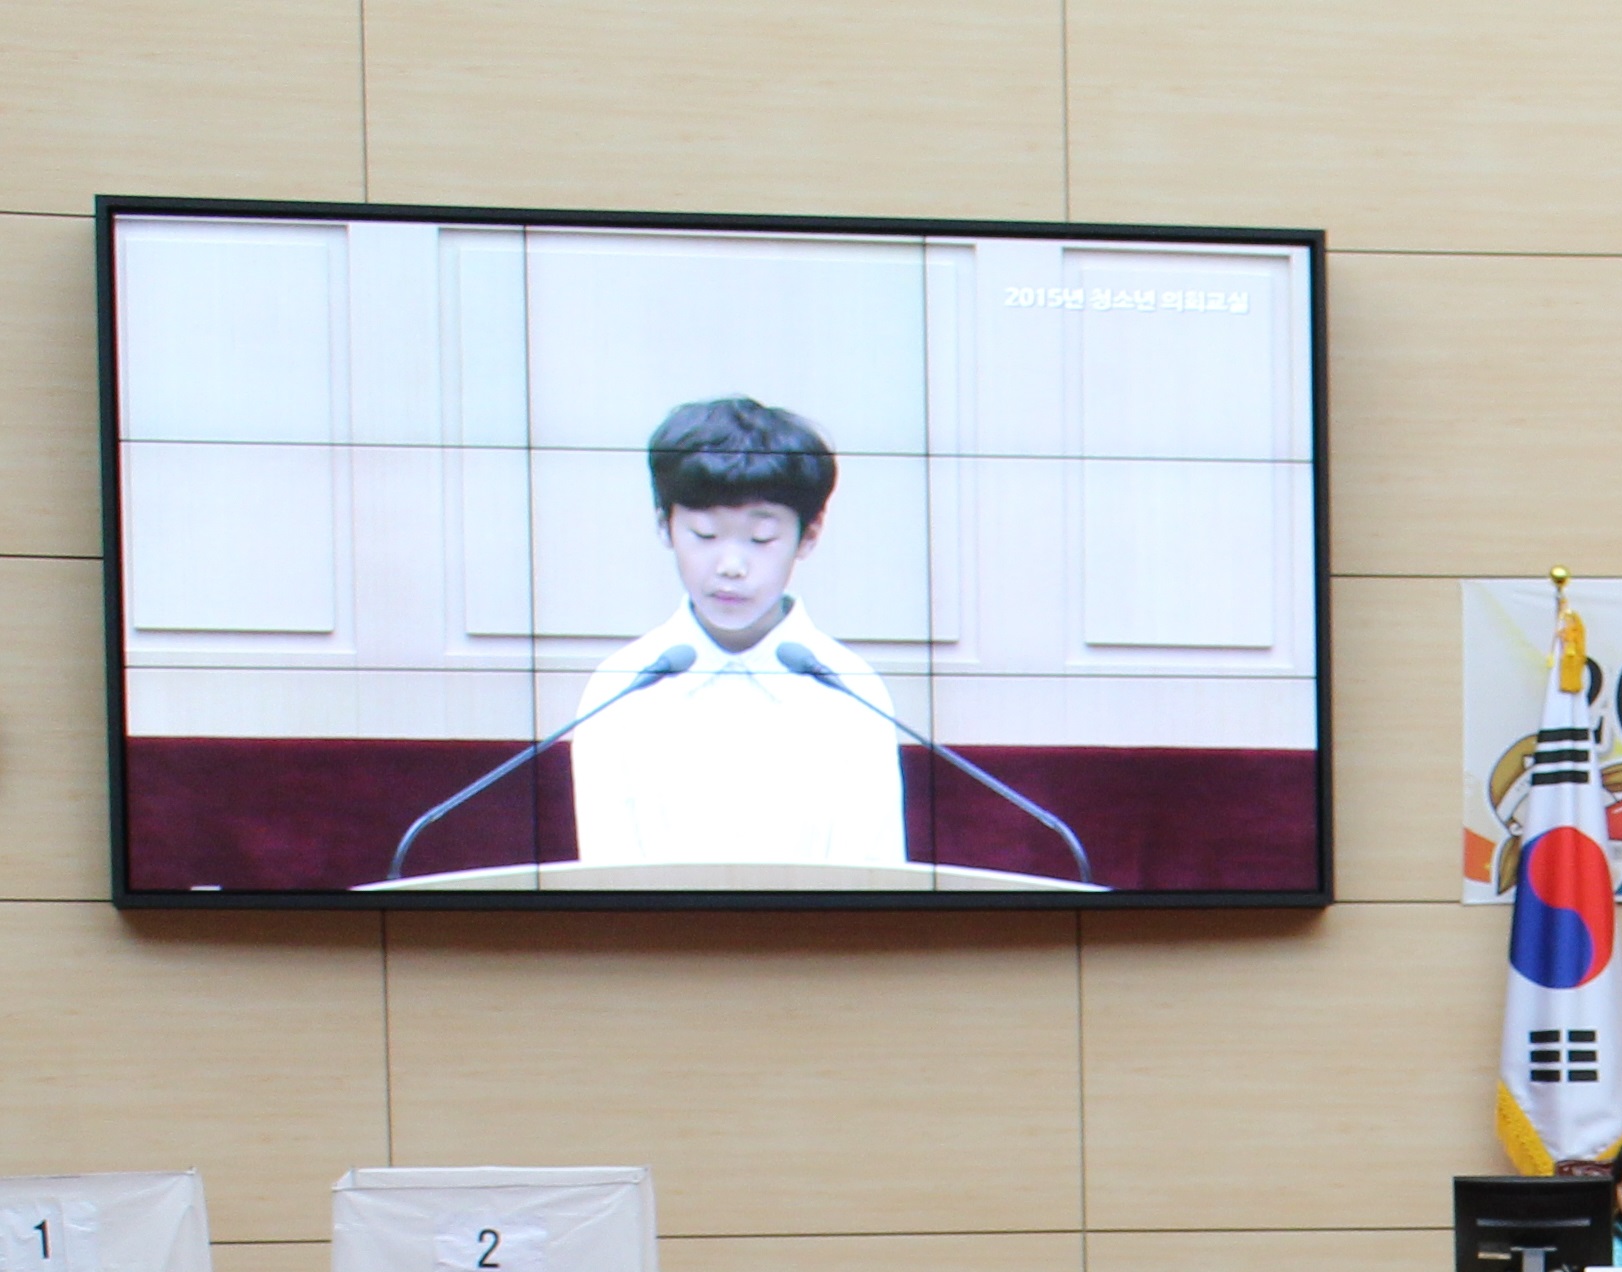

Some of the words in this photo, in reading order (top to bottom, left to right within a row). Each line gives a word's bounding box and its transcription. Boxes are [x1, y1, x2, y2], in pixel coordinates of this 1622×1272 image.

[1004, 286, 1084, 310] 2015년
[33, 1220, 50, 1260] 1
[477, 1229, 501, 1268] 2
